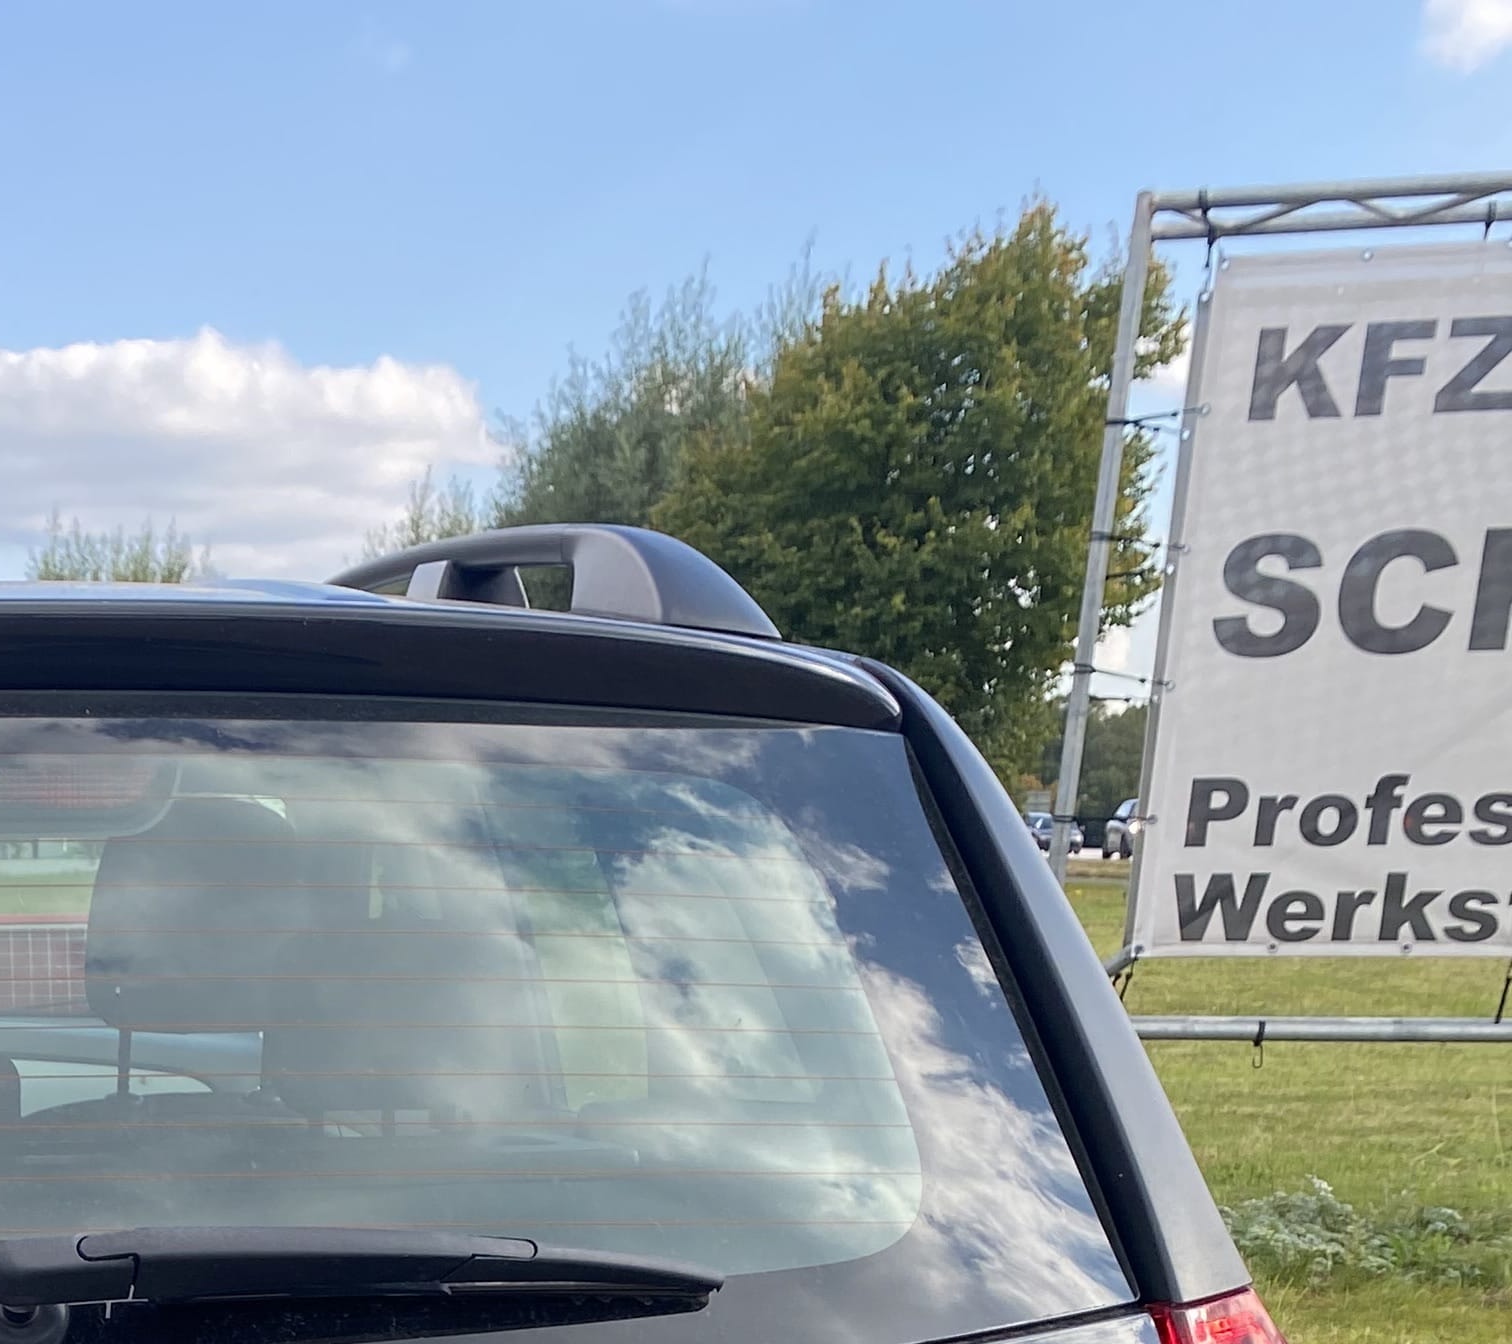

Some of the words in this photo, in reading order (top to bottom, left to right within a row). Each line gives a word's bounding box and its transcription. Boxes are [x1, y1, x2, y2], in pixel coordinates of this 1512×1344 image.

[1248, 315, 1512, 421] KFZ
[1184, 774, 1512, 847] Profes
[1174, 872, 1512, 942] Werks
